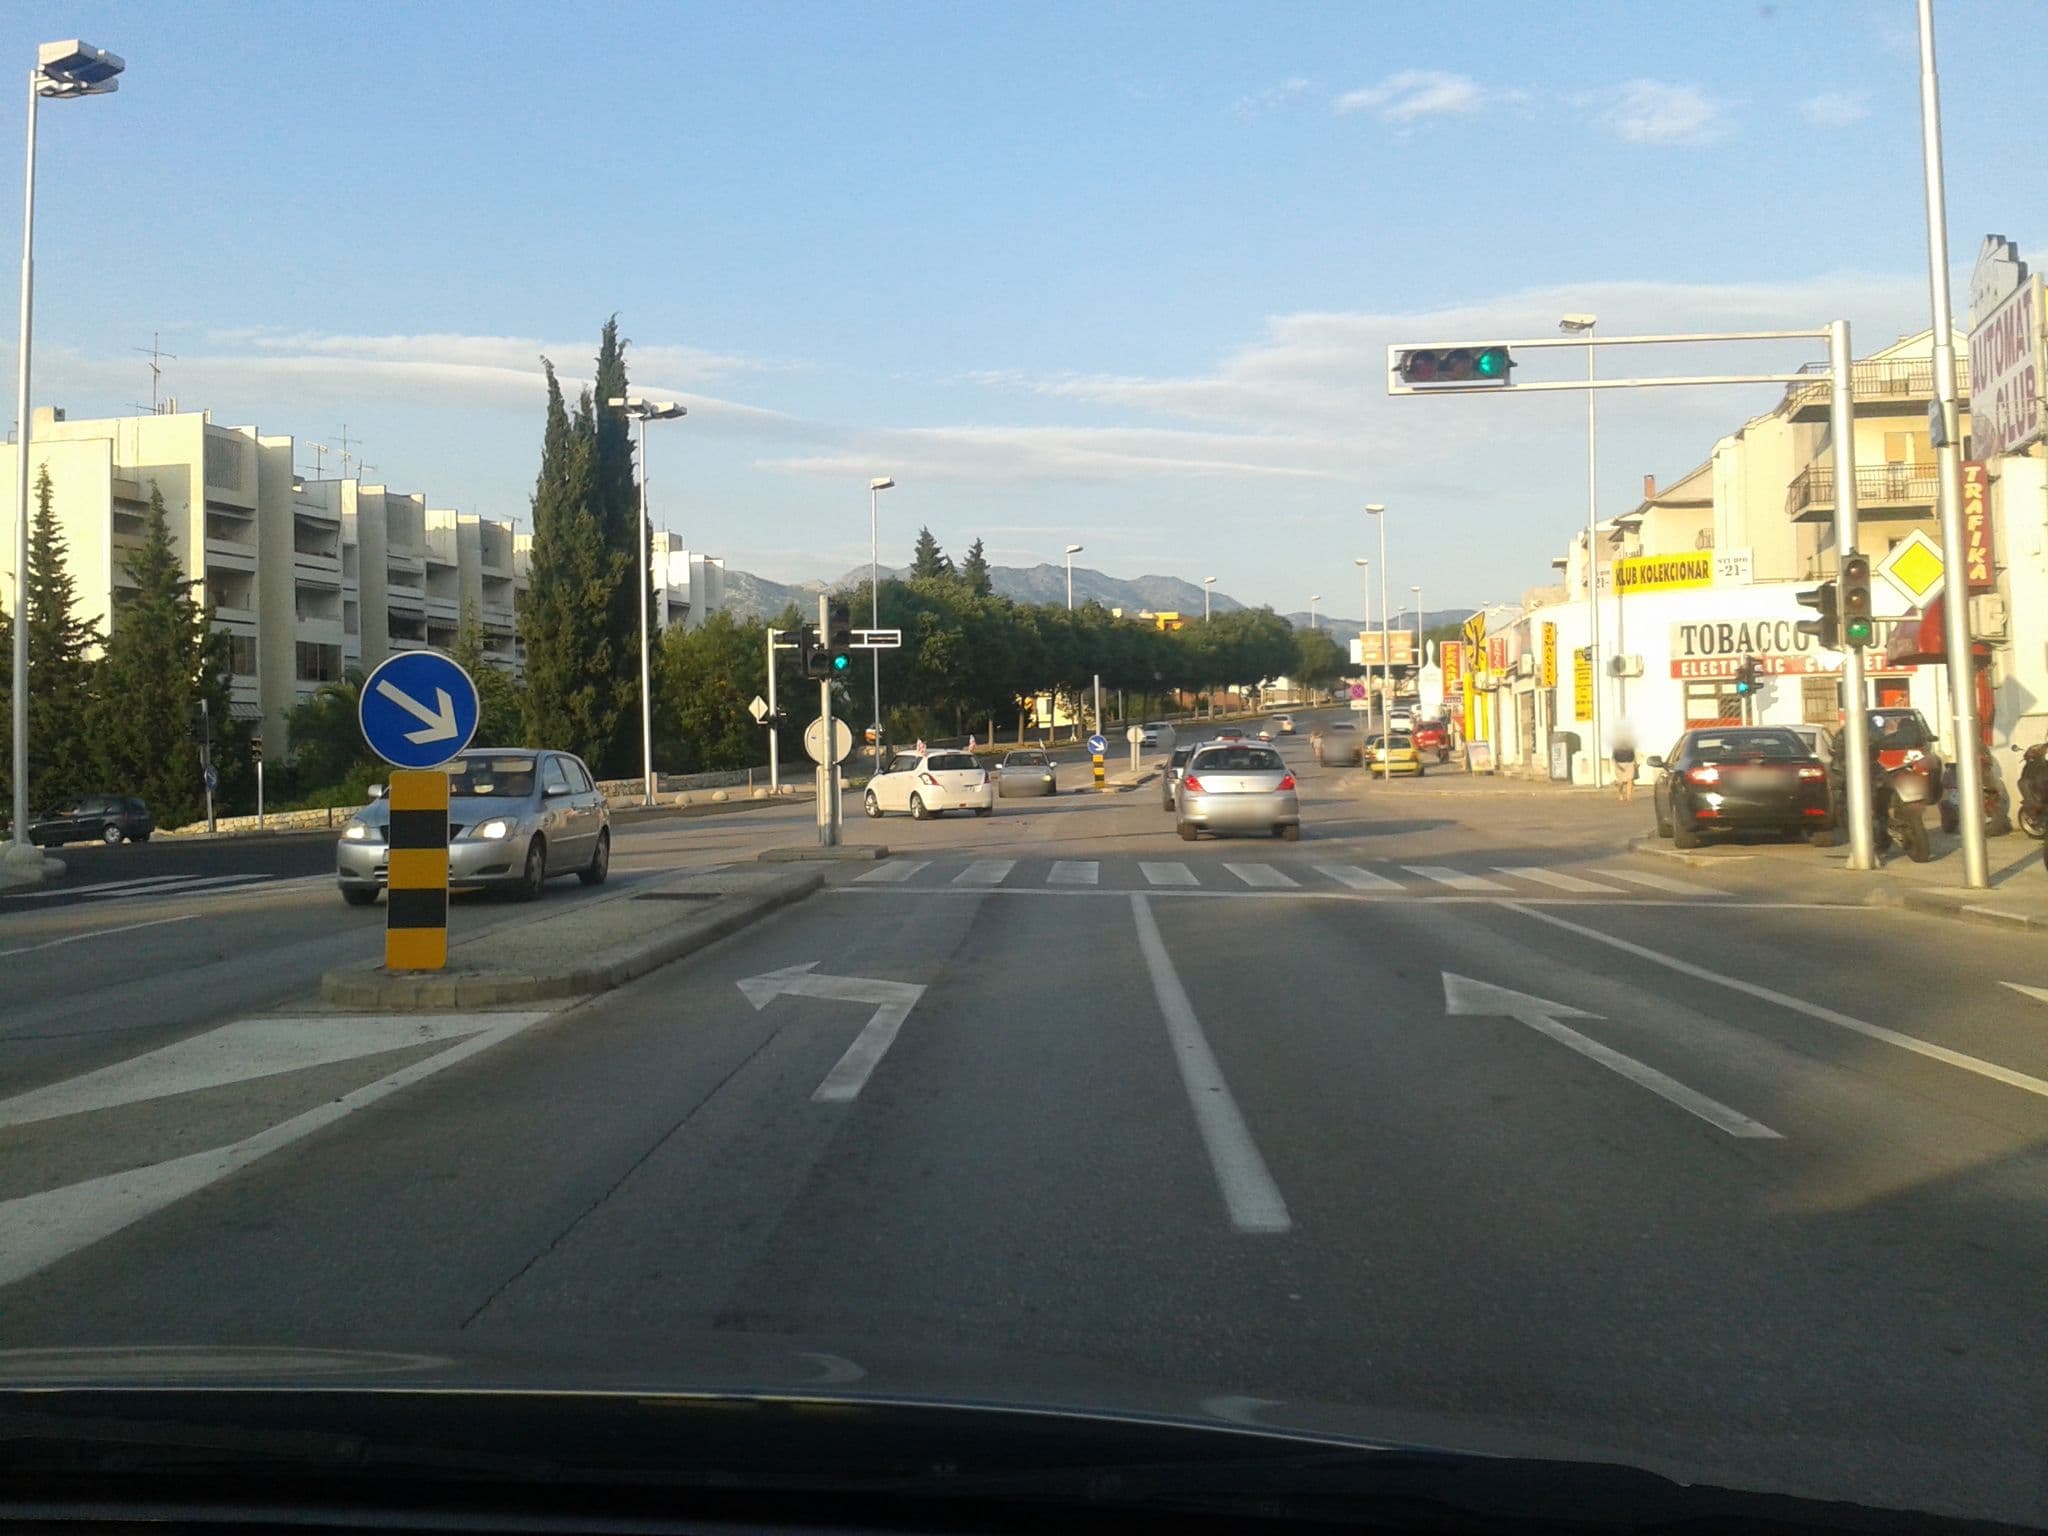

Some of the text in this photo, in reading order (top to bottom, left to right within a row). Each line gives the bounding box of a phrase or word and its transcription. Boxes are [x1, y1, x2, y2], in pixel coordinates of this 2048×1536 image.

[1971, 290, 2034, 399] AUTOMAT
[1996, 363, 2038, 443] CLUB
[1963, 466, 1988, 581] TRAFIKA
[1615, 560, 1710, 587] KLUB KOLEKCIONAR
[1680, 620, 1810, 655] TOBACCO
[1681, 656, 1786, 676] ELECTRIC
